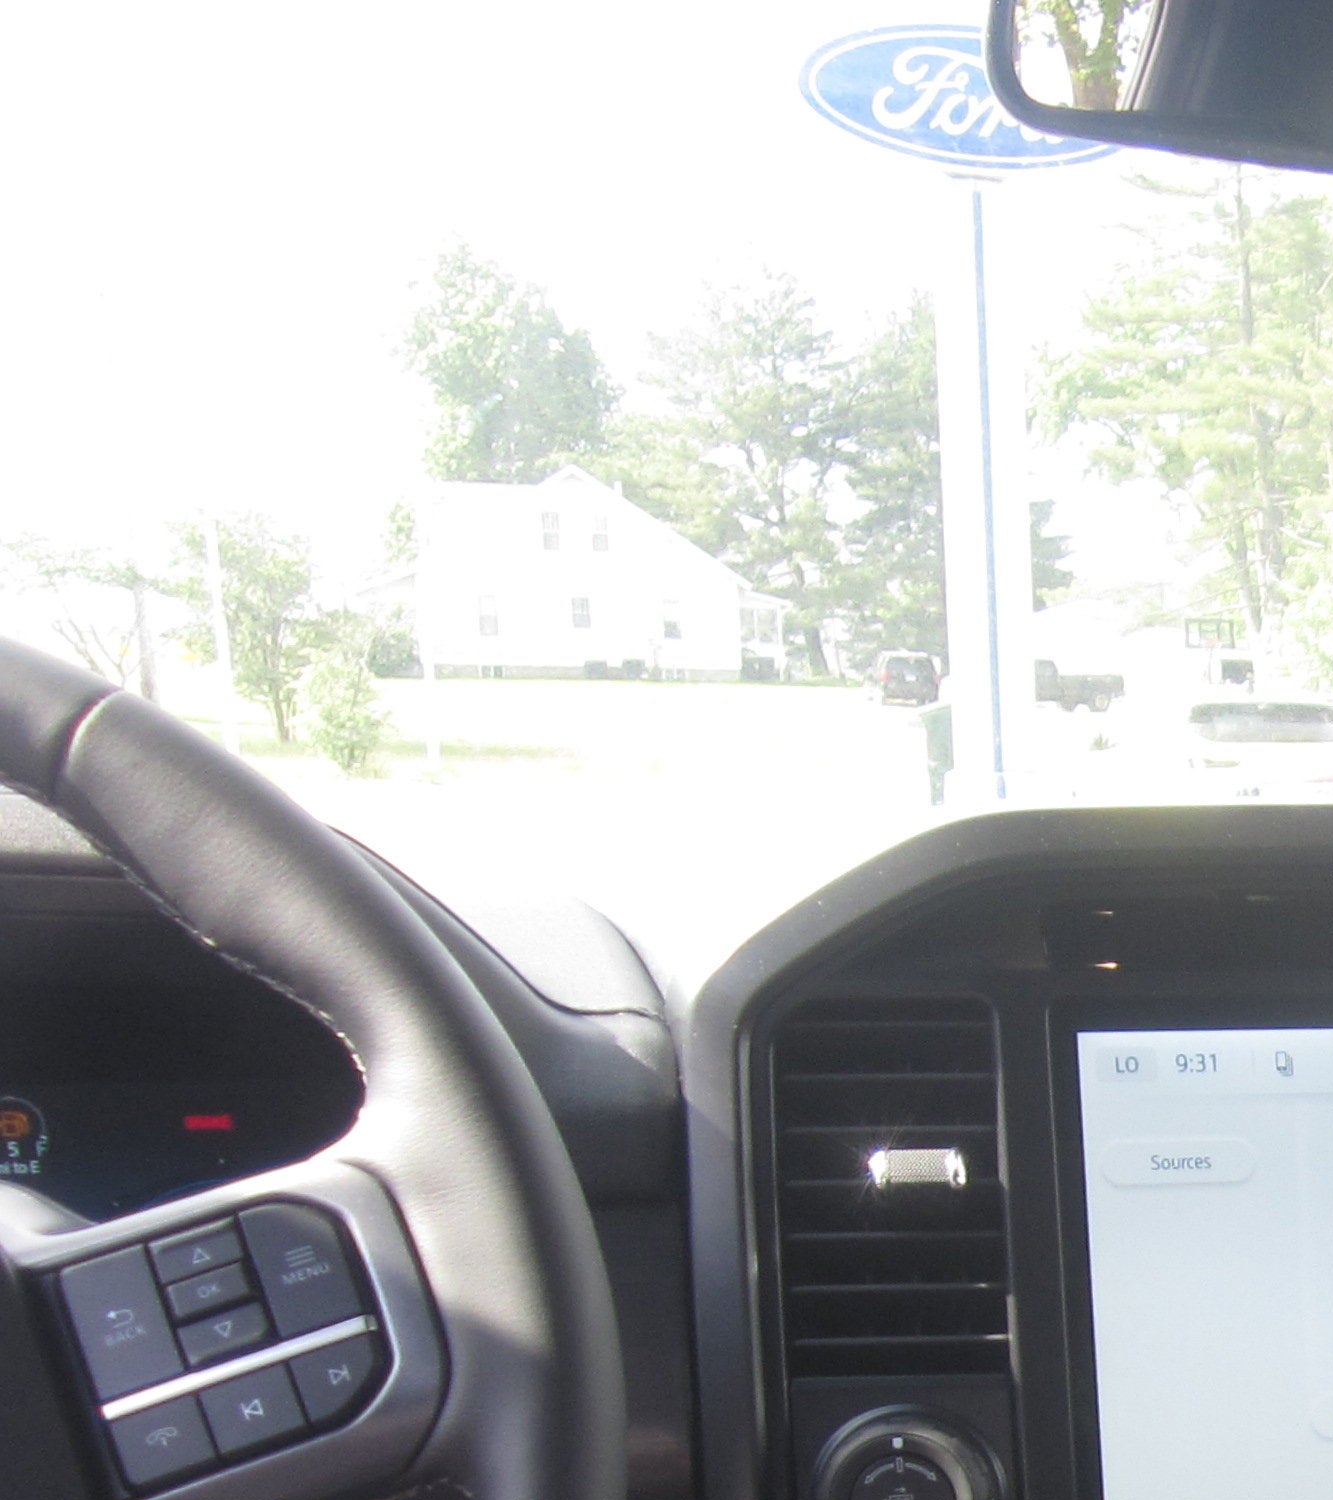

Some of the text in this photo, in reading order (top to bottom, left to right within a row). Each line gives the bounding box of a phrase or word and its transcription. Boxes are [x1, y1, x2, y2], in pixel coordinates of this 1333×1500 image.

[1114, 1055, 1140, 1075] LO
[1174, 1053, 1219, 1074] 9:31
[1150, 1153, 1212, 1172] Sources
[282, 1263, 330, 1286] MENU
